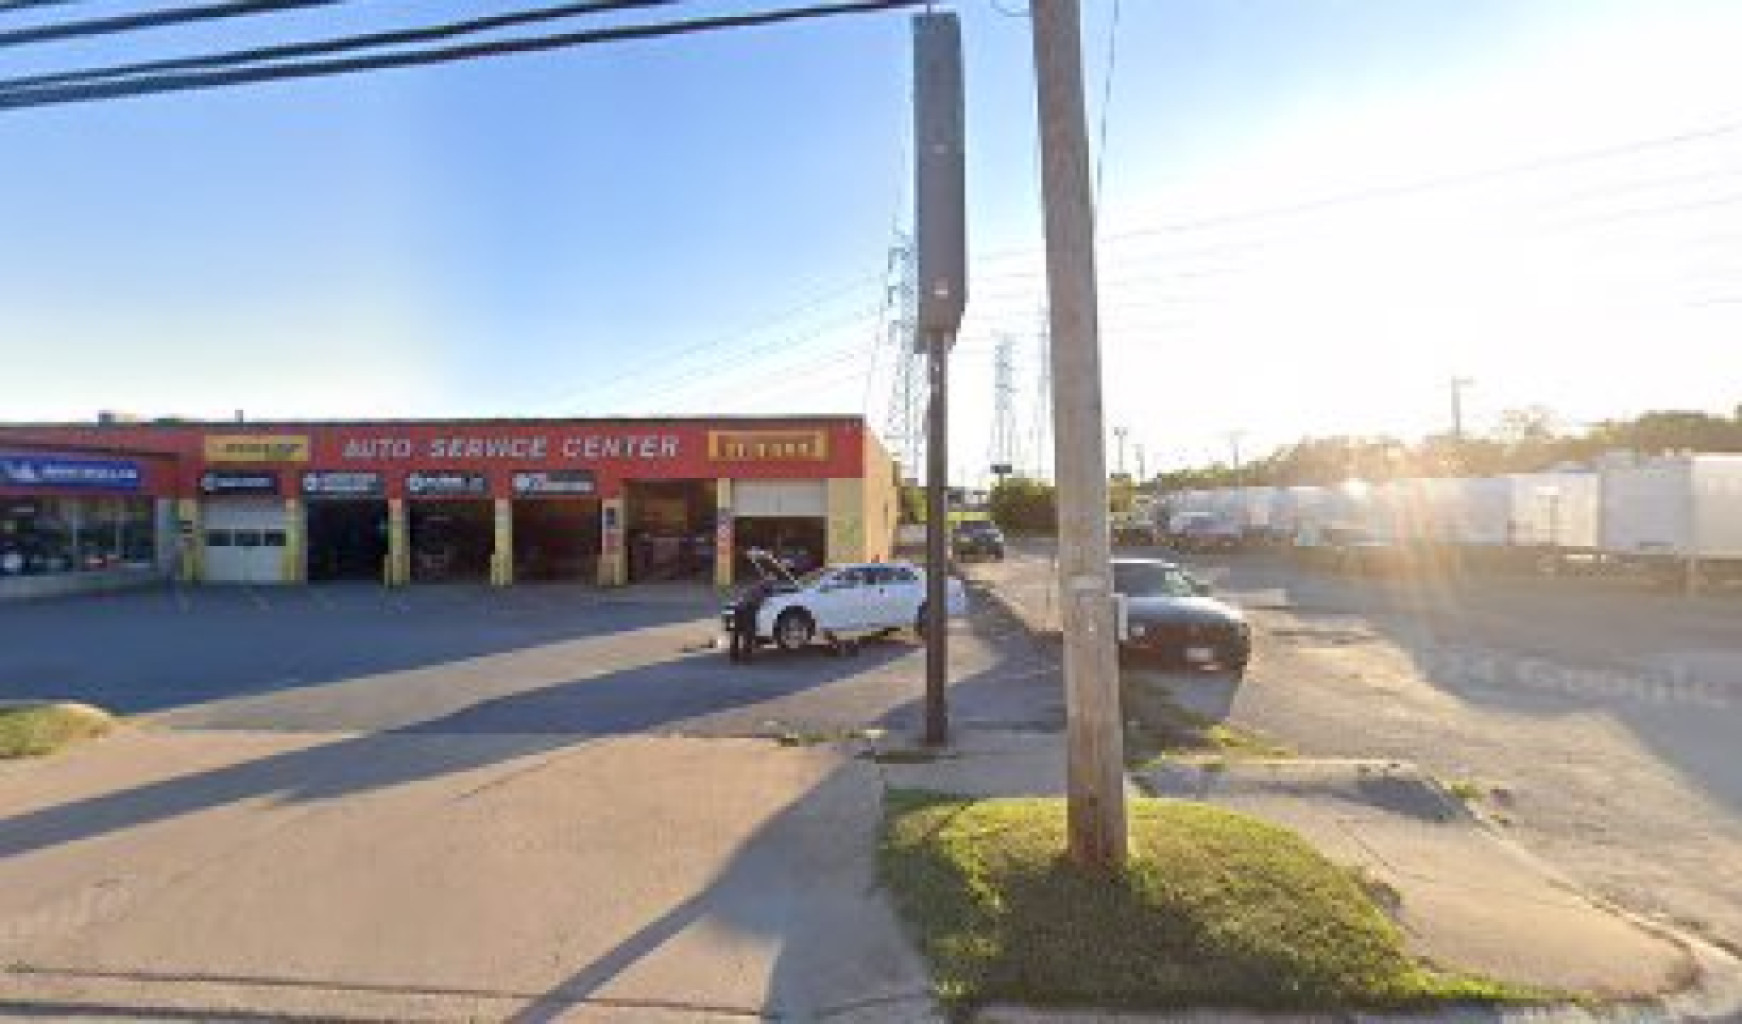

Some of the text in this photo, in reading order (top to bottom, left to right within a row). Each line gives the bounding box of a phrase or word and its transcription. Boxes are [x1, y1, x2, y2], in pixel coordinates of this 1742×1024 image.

[342, 434, 680, 459] AUTO SERVICE CENTER
